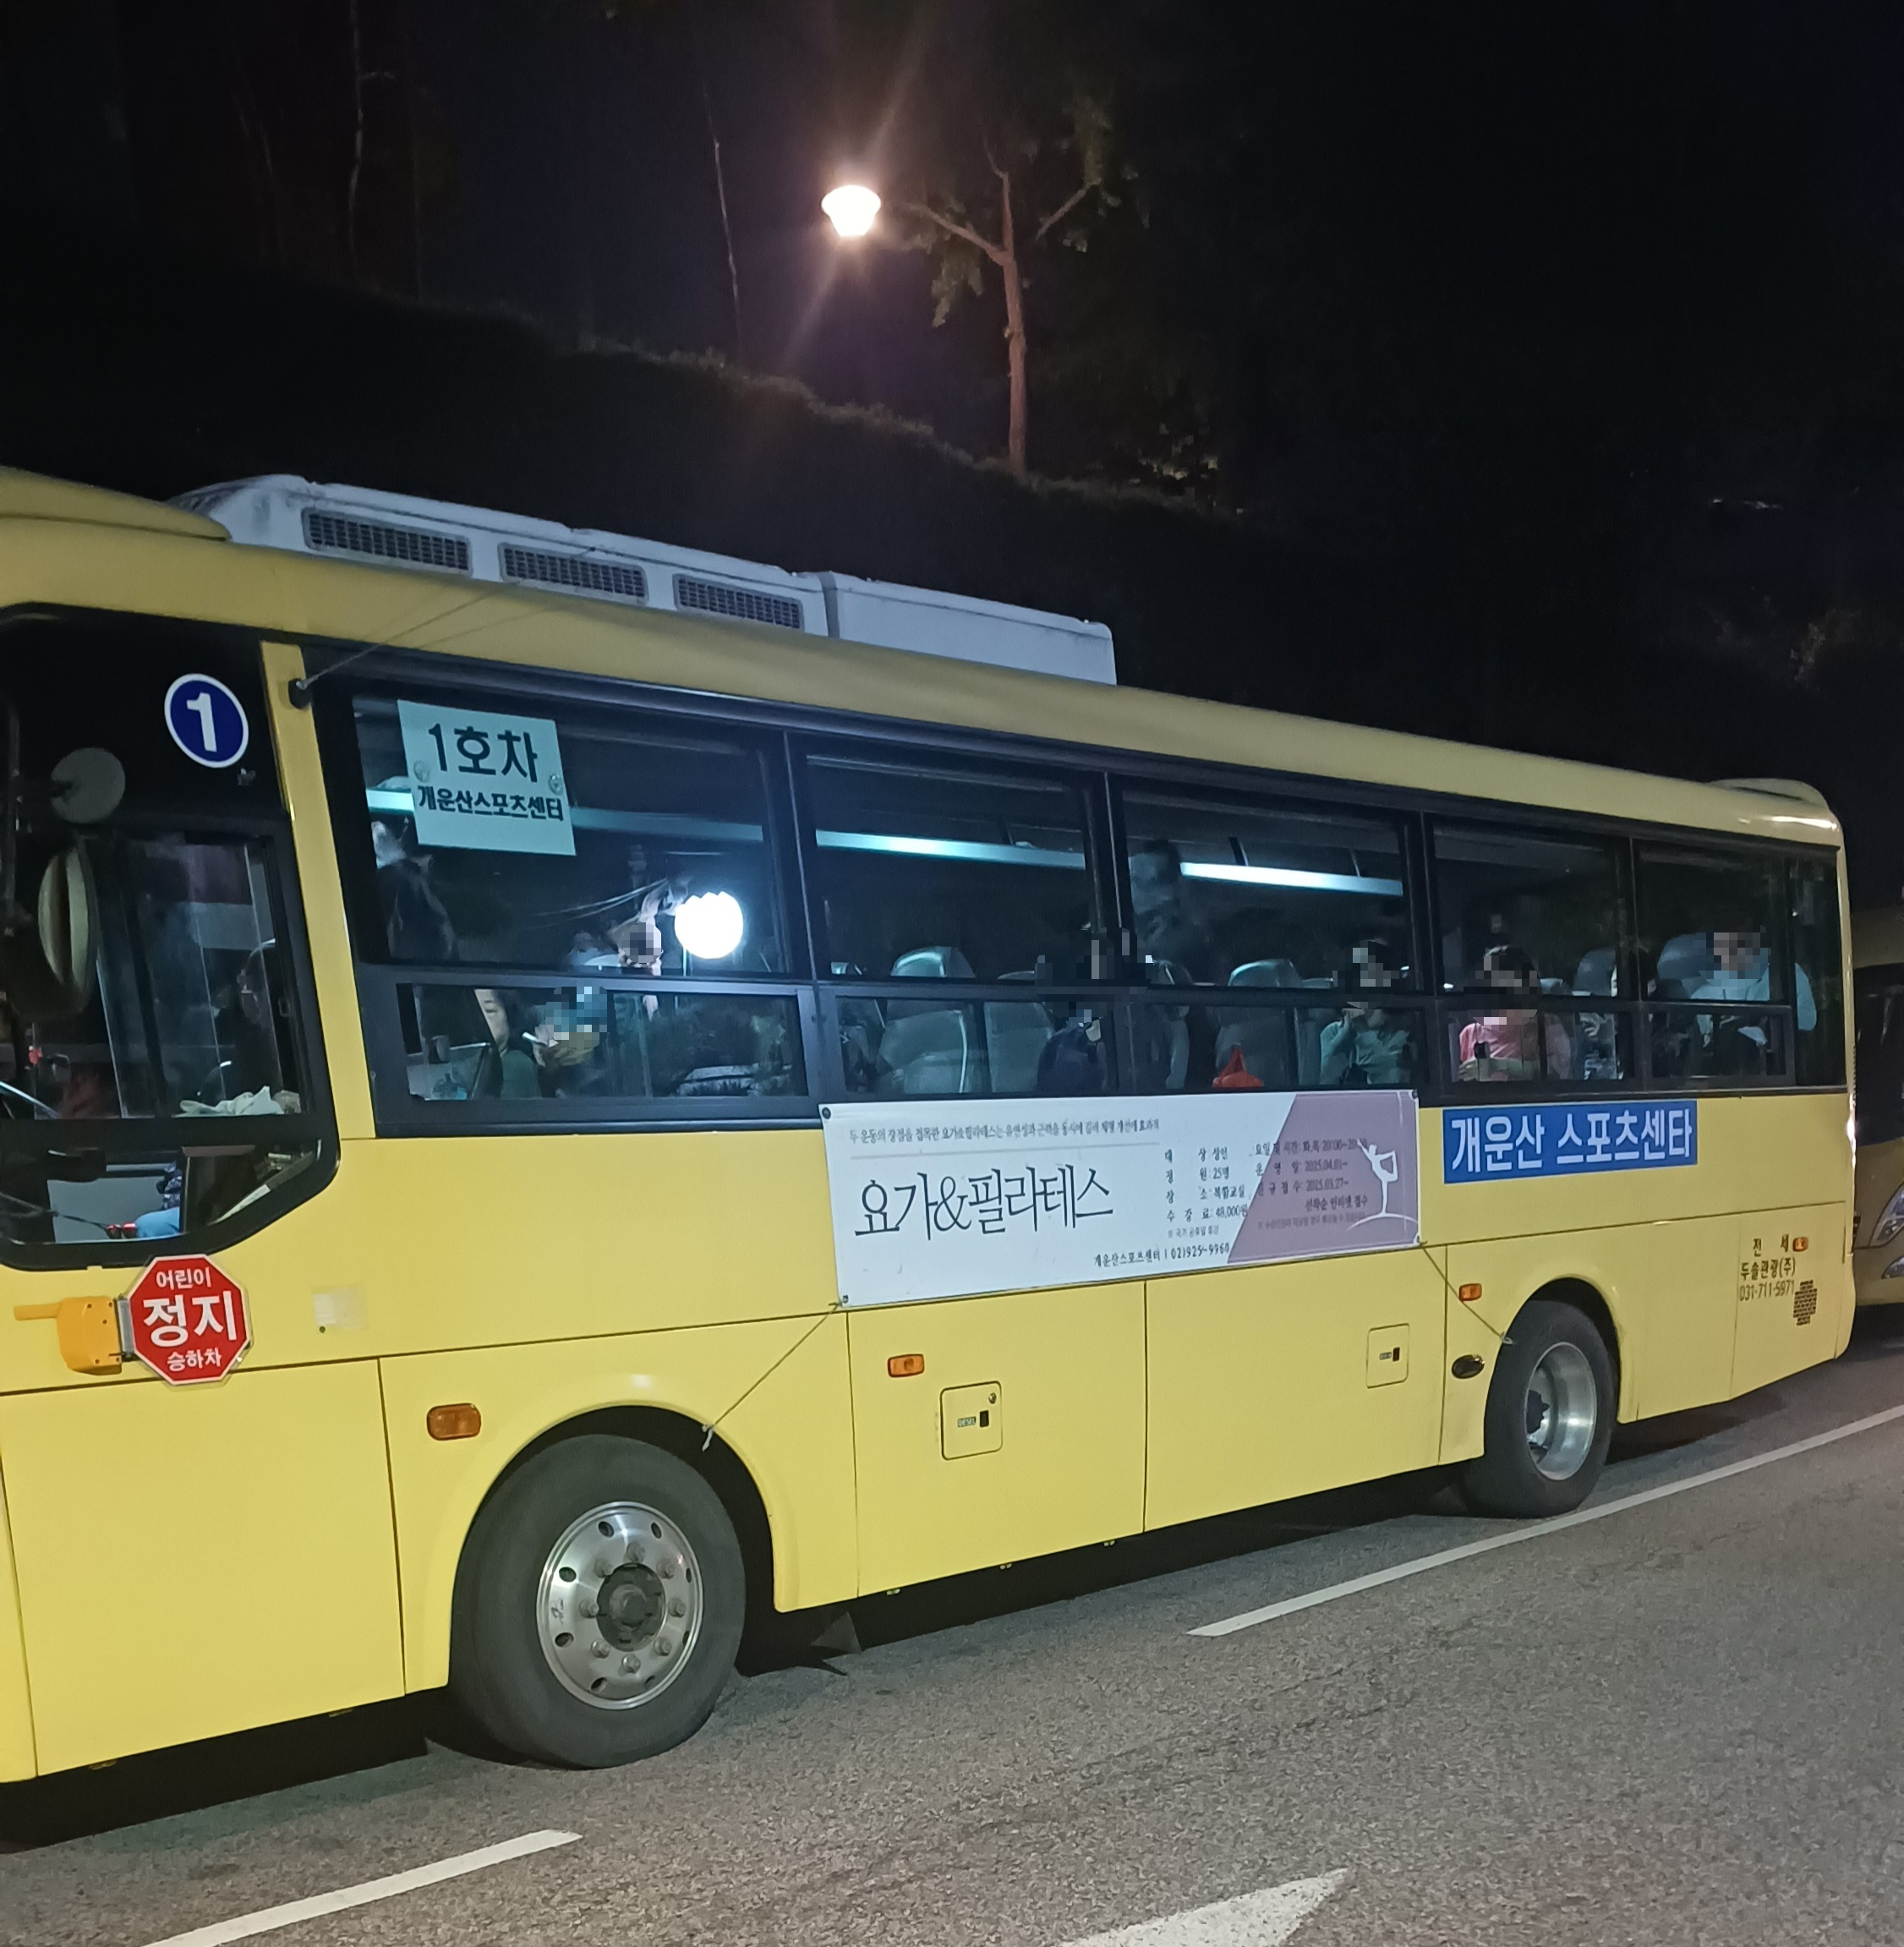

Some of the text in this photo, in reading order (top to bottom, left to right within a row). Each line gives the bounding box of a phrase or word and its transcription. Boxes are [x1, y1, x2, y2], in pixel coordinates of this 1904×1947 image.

[187, 692, 217, 752] 1
[428, 723, 538, 783] 1호차
[417, 785, 564, 821] 개운산스포츠센터
[850, 1129, 858, 1145] 두
[860, 1128, 886, 1144] 운동의
[1451, 1108, 1693, 1173] 개운산 스포츠센타
[855, 1163, 1113, 1241] 요가&필라테스
[156, 1267, 211, 1291] 어린이
[143, 1290, 238, 1348] 정지
[167, 1347, 222, 1372] 승하차
